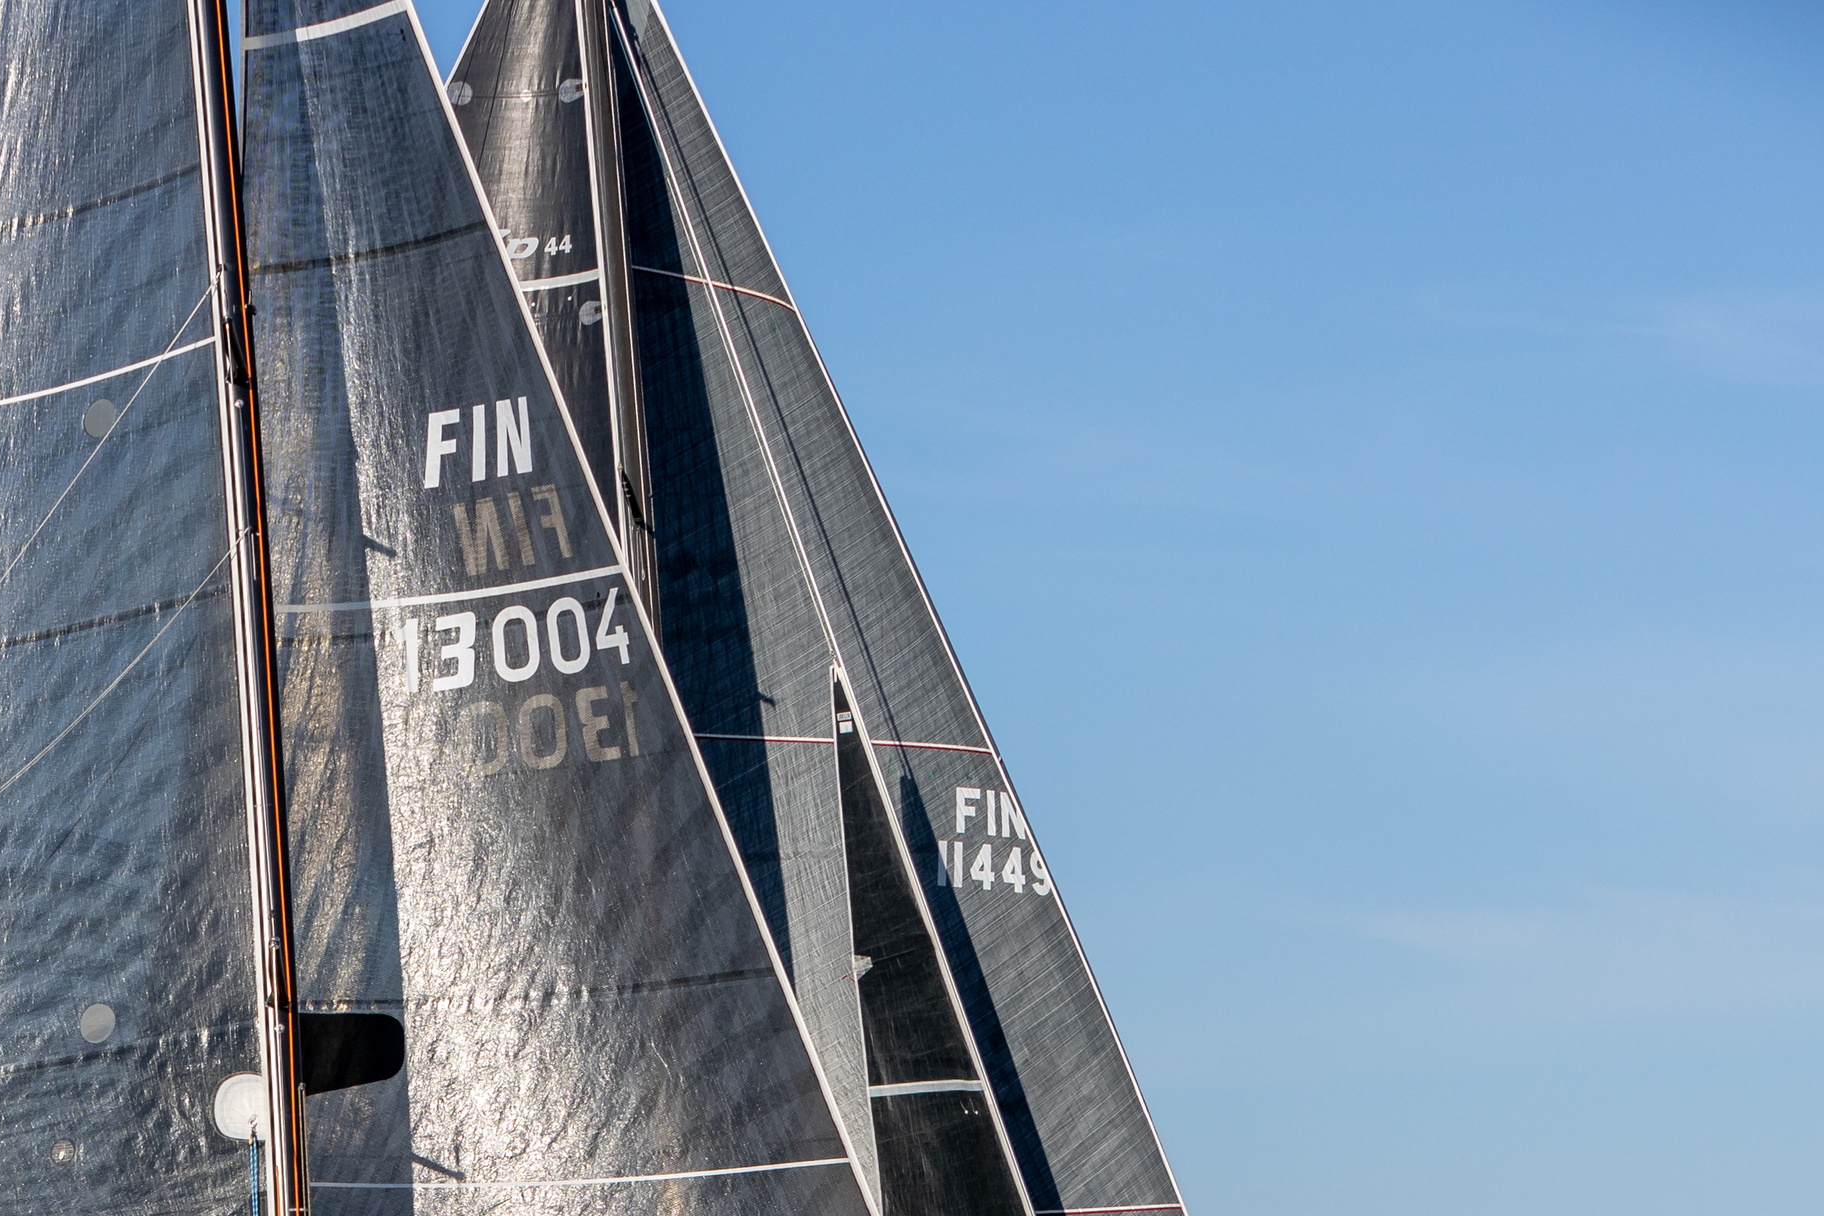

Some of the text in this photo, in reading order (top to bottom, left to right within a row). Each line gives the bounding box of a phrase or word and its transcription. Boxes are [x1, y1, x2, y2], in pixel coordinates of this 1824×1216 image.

[544, 234, 572, 256] 44
[424, 396, 533, 489] FIN
[396, 587, 630, 694] 13004
[956, 786, 1026, 840] FIN
[937, 839, 1051, 897] 11449
